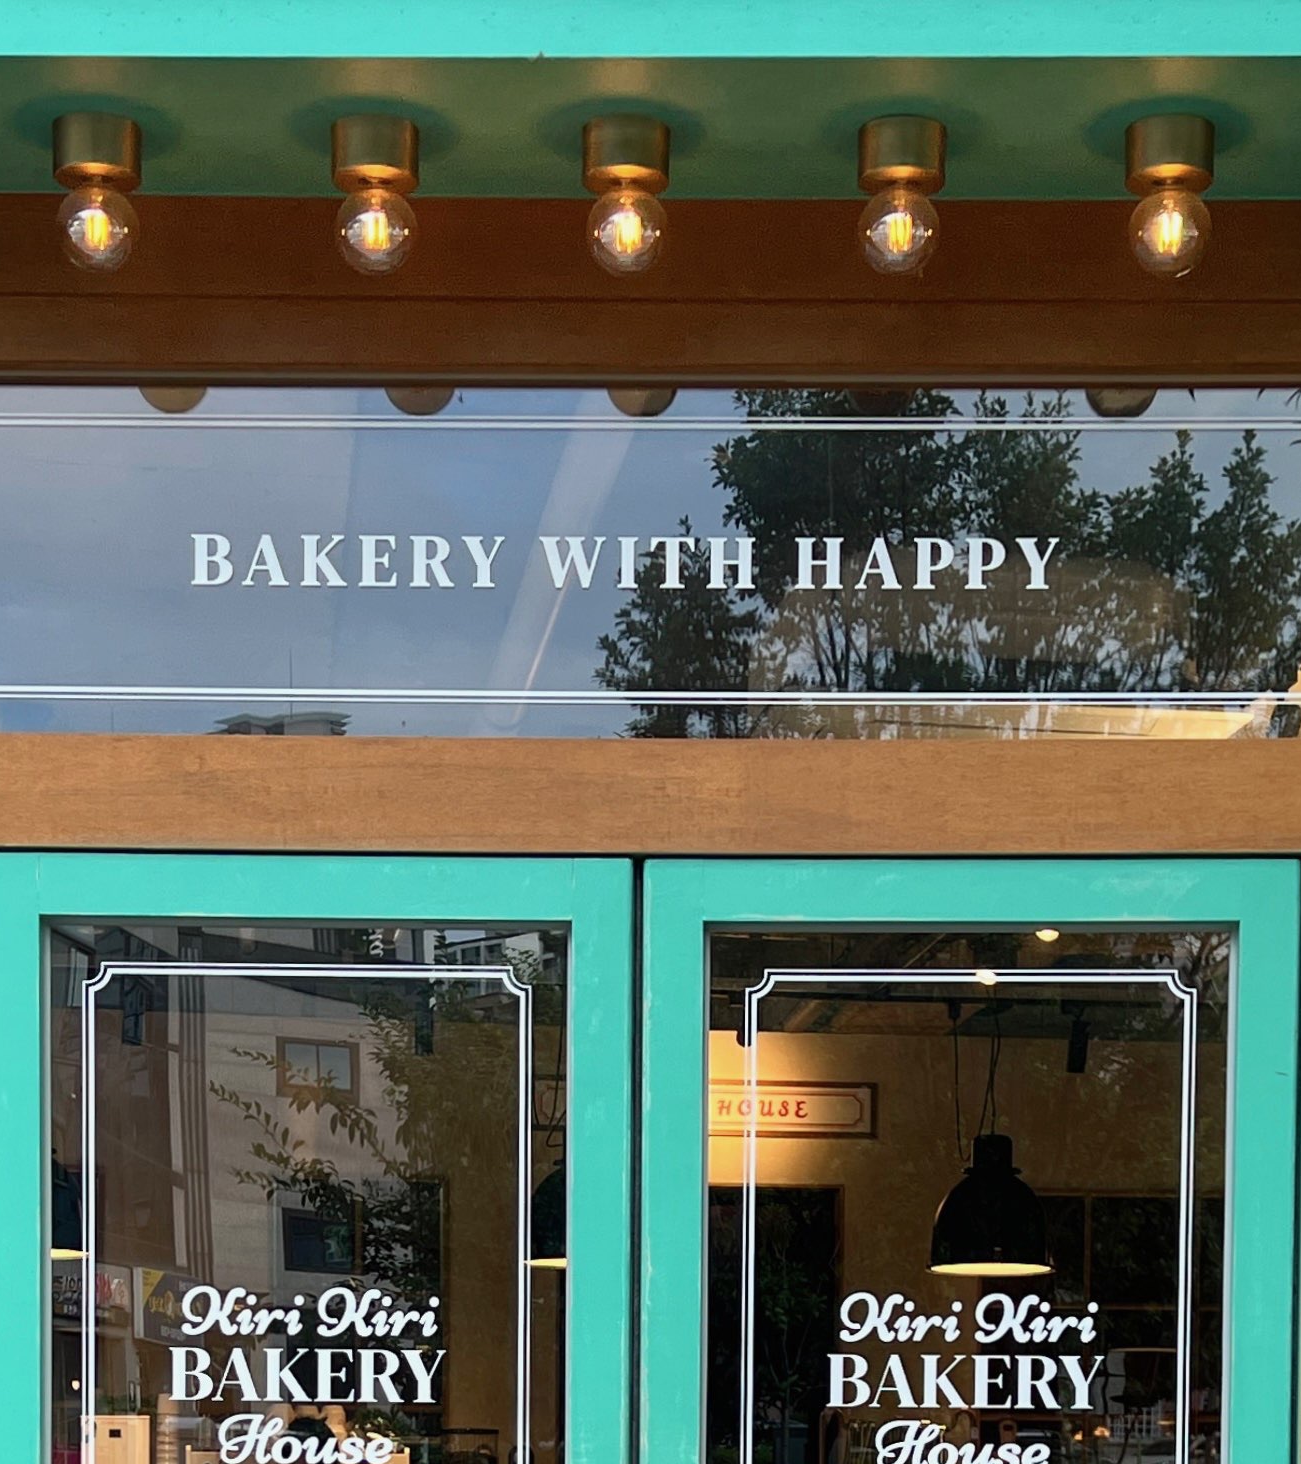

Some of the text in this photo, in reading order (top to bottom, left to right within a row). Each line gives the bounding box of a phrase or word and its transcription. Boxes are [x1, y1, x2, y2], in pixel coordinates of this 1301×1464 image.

[190, 532, 1060, 590] BAKERY WITH HAPPY
[717, 1099, 809, 1119] HOUSE
[181, 1285, 305, 1337] Kiri
[317, 1287, 441, 1338] Kiri
[839, 1292, 1099, 1344] Kiri Kiri
[168, 1346, 447, 1404] BAKERY
[826, 1353, 1105, 1410] BAKERY
